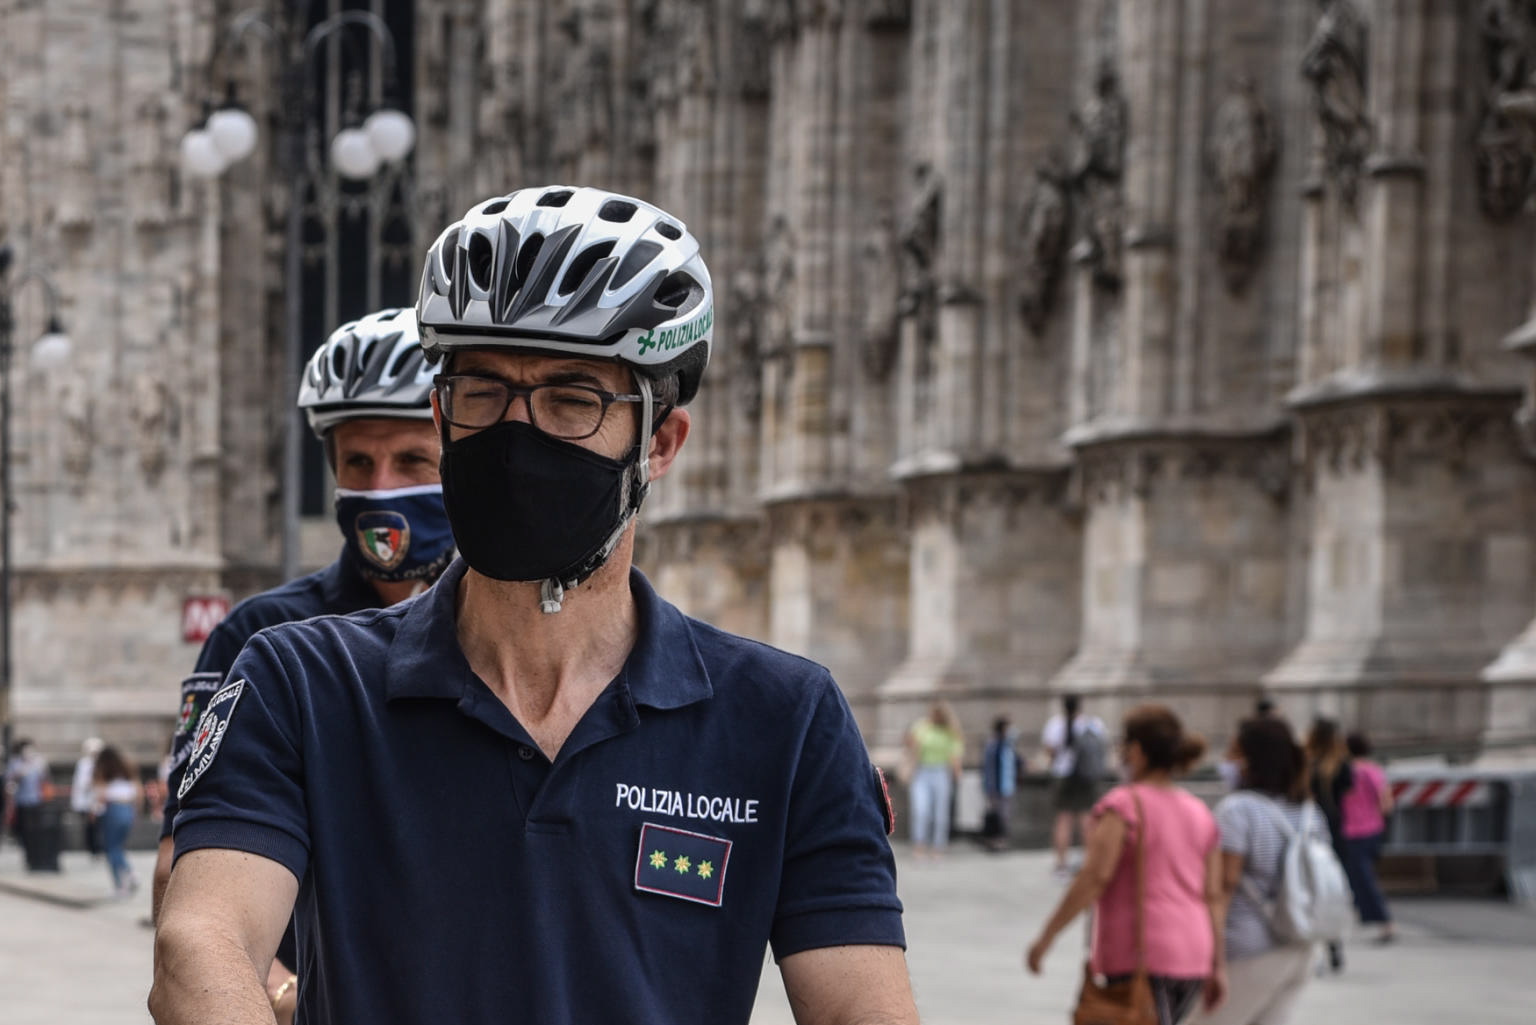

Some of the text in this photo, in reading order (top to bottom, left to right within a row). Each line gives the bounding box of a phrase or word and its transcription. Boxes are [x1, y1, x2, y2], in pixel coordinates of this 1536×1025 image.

[657, 322, 693, 352] POLIZIA
[193, 719, 227, 778] MILANO
[616, 783, 759, 823] POLIZIA LOCALE
